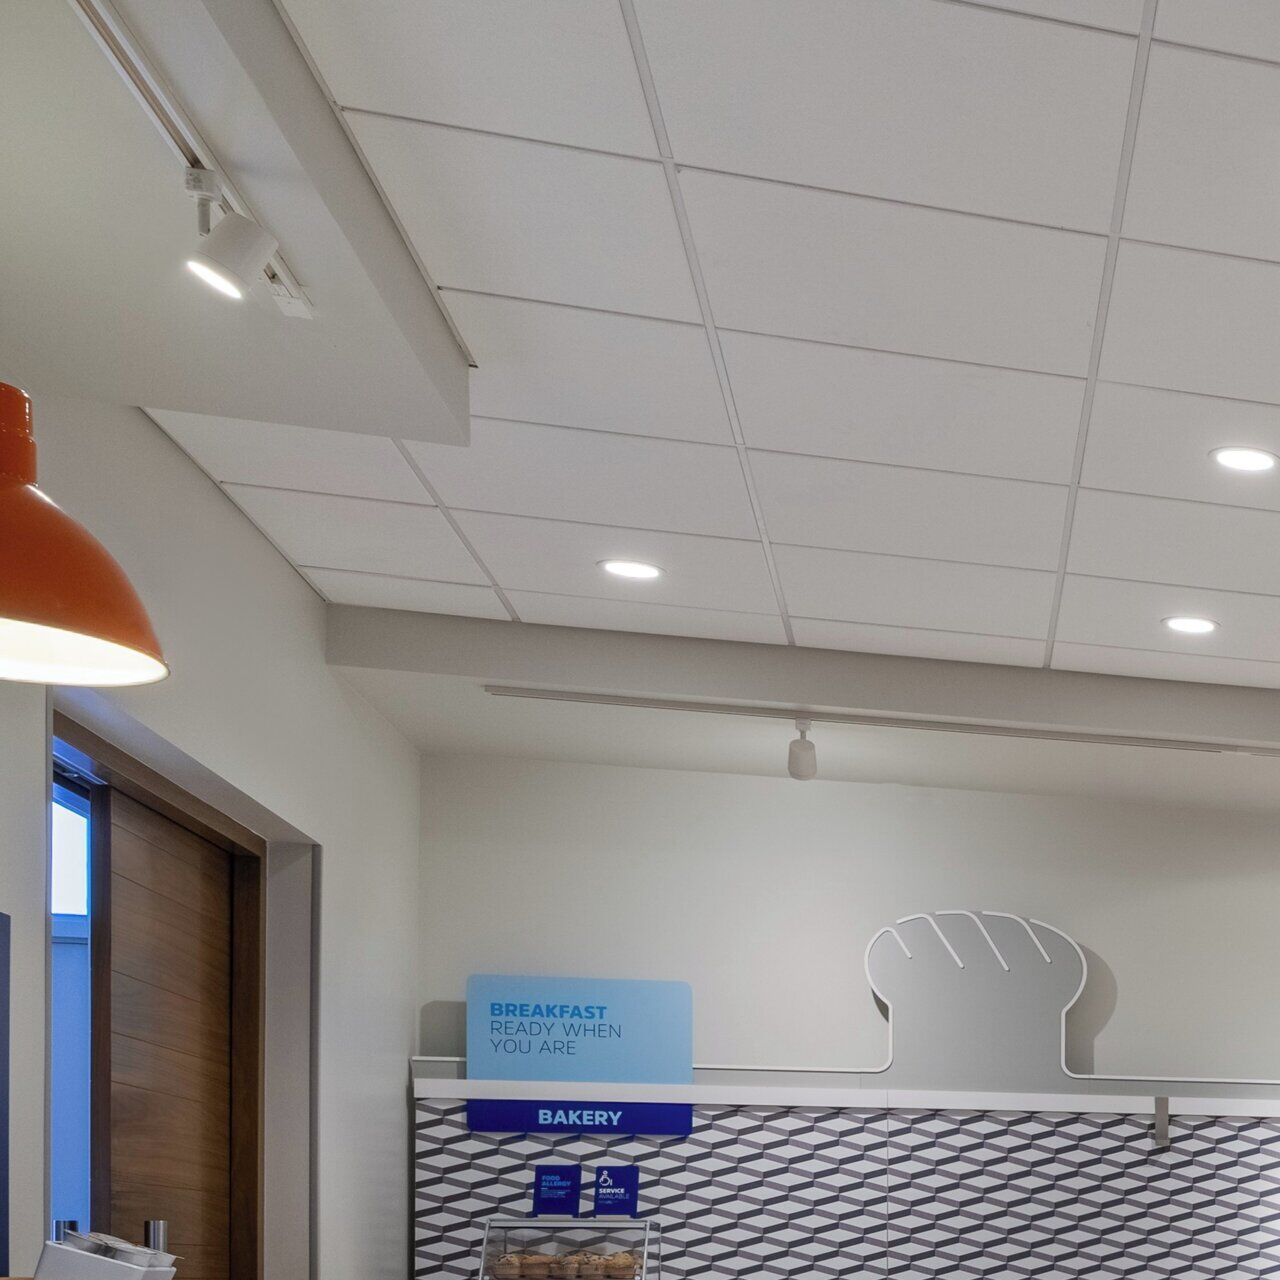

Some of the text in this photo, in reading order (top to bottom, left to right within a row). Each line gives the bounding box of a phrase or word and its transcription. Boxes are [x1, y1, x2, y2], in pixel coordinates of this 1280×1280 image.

[490, 1002, 607, 1019] BREAKFAST
[490, 1020, 621, 1038] READY WHEN
[490, 1038, 576, 1055] YOU ARE
[538, 1109, 622, 1126] BAKERY
